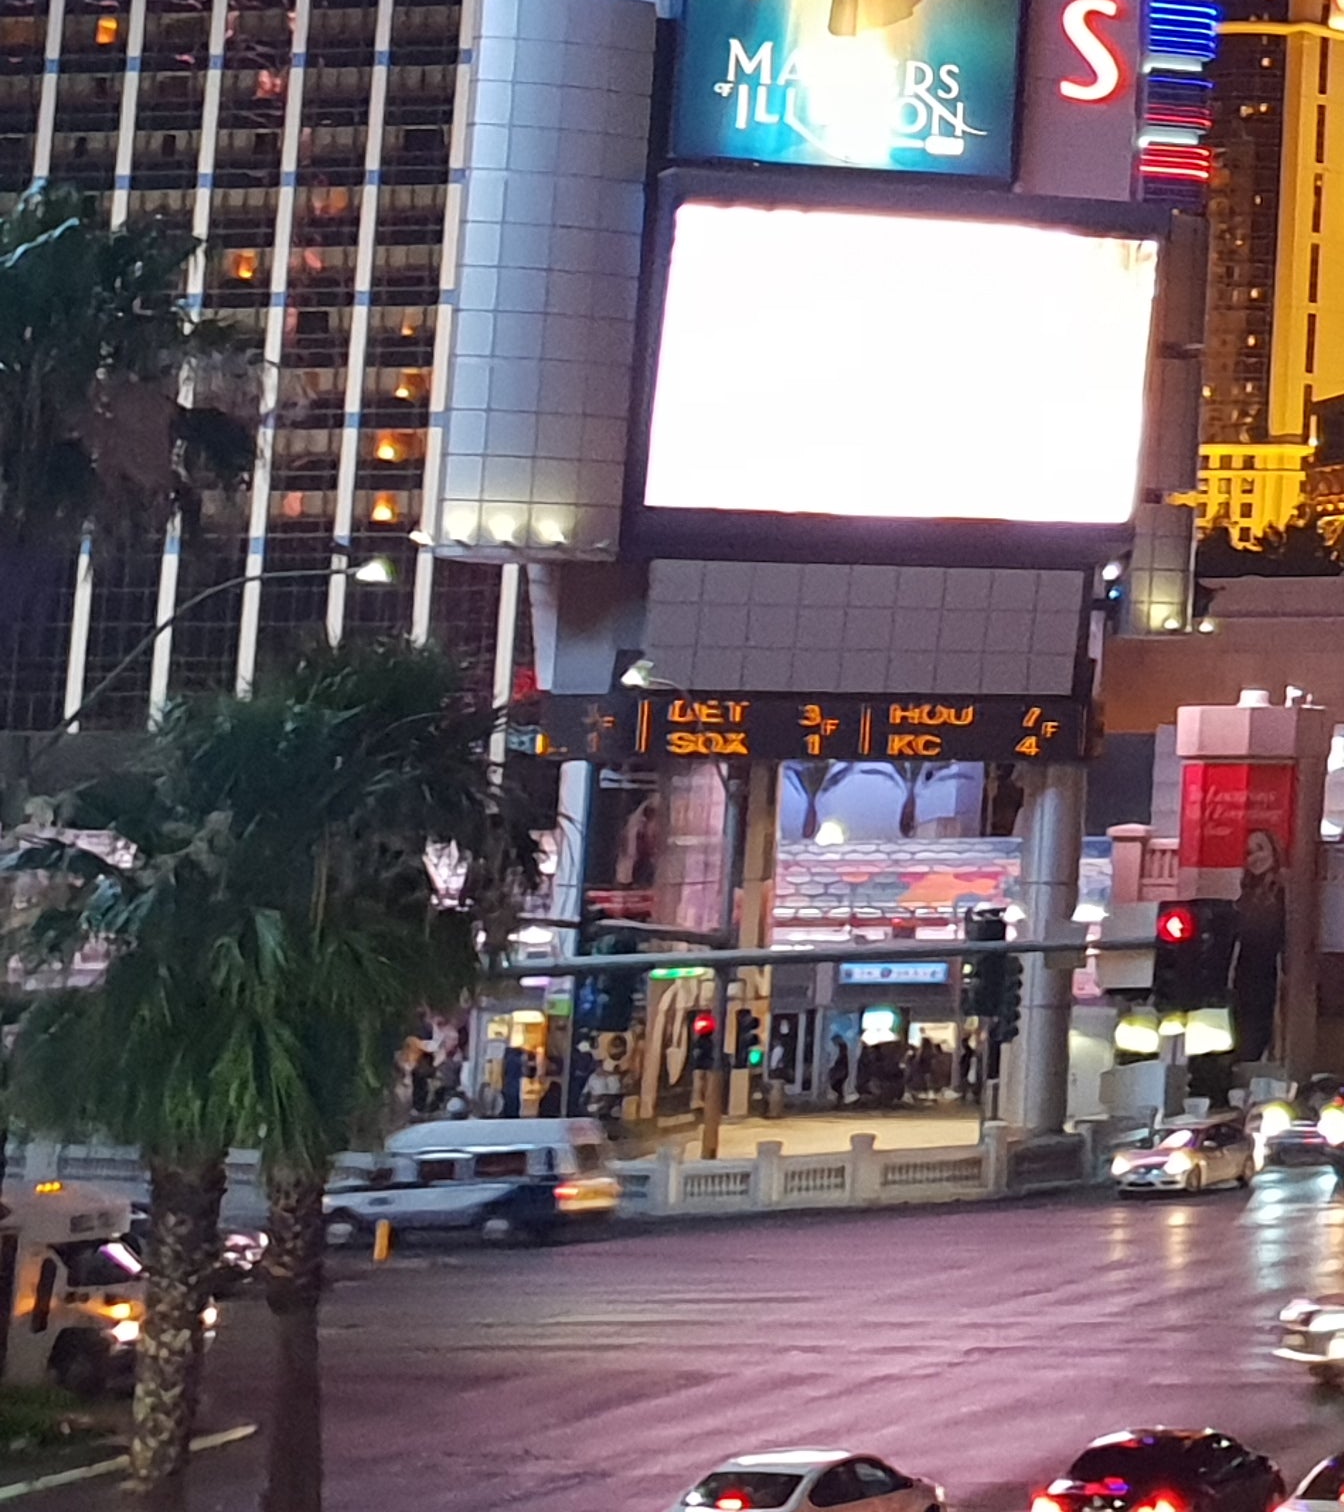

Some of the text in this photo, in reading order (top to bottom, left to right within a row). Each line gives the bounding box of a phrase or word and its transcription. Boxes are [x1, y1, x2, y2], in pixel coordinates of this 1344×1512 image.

[726, 38, 961, 100] MARS
[799, 704, 822, 727] 3
[889, 704, 975, 726] HOU
[666, 732, 750, 755] SOX
[805, 734, 822, 755] 1
[887, 734, 942, 756] KC
[1015, 734, 1040, 756] 4
